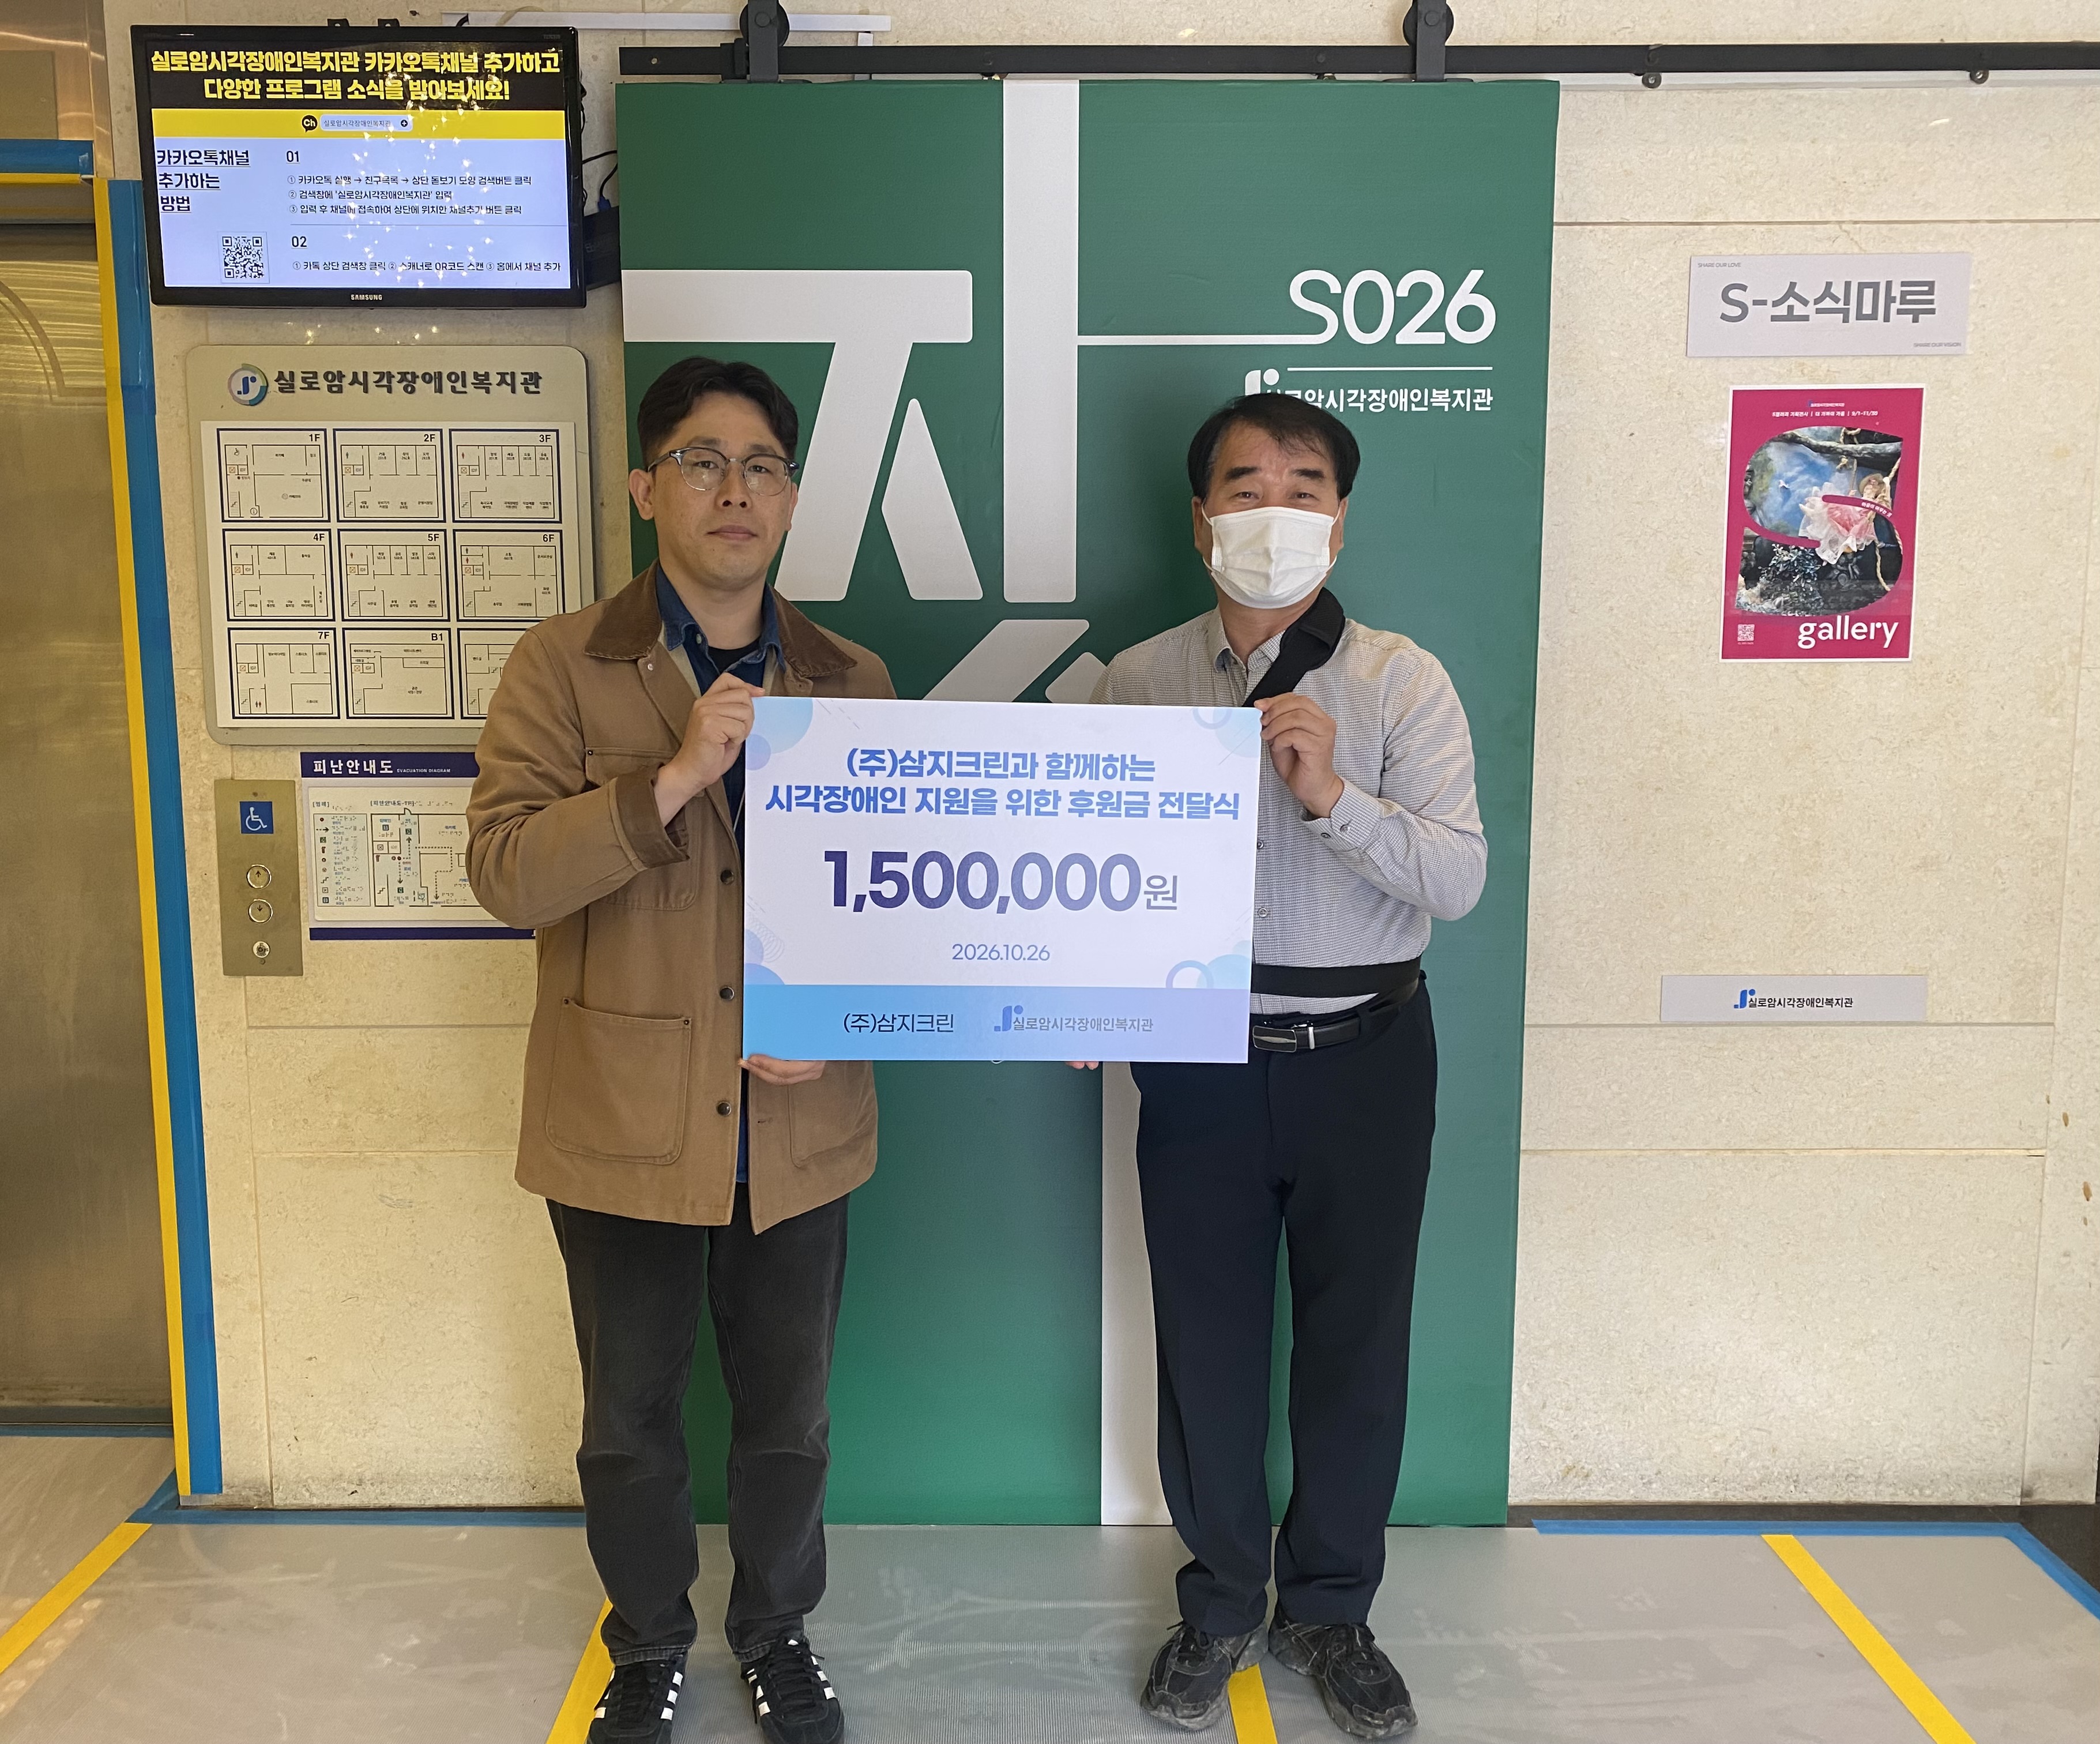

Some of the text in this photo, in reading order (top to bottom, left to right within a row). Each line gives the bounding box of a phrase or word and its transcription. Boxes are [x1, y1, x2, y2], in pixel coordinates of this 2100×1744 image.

[151, 51, 560, 73] 실로암시각장애인복지관 카카오톡채널 추가하고
[204, 78, 510, 101] 다양한 프로그램 소식을 받아보세요!
[303, 119, 316, 127] Ch
[157, 149, 250, 166] 카카오톡채널
[286, 151, 299, 162] 01
[159, 172, 220, 189] 추가하는
[298, 175, 332, 185] 카카오톡
[412, 176, 428, 185] 상단
[431, 176, 457, 185] 돋보기
[514, 176, 531, 185] 클릭
[299, 190, 333, 199] 검색창에
[435, 190, 452, 200] 입력
[160, 196, 190, 212] 방법
[300, 205, 317, 214] 입력
[319, 205, 328, 214] 후
[357, 205, 391, 214] 접속하여
[394, 205, 419, 214] 상단에
[421, 205, 447, 215] 위치한
[505, 206, 522, 215] 클릭
[292, 236, 307, 247] 02
[303, 261, 319, 270] 카톡
[322, 261, 339, 270] 상단
[342, 261, 367, 270] 검색창
[369, 262, 386, 270] 클릭
[467, 262, 484, 270] 스캔
[497, 262, 522, 272] 홈에서
[524, 262, 541, 272] 채널
[544, 262, 560, 272] 추가
[1720, 280, 1936, 324] S-소식마루
[274, 370, 542, 394] 실로암시각장애인복지관
[1267, 389, 1493, 412] 암시각장애인복지관
[309, 434, 320, 442] 1F
[424, 434, 435, 442] 2F
[539, 434, 551, 443] 3F
[428, 533, 439, 542] 5F
[543, 534, 554, 542] 6F
[1798, 615, 1899, 649] gallery
[313, 760, 393, 775] 피난안내도
[847, 748, 1156, 781] (주)삼지크린과 함께하는
[766, 785, 1240, 820] 시각장애인 지원을 위한 후원금 전달식
[825, 850, 1177, 914] 1,500,000원
[952, 944, 1051, 961] 2026.10.26
[1748, 997, 1853, 1008] 실로암시각장애인복지관
[843, 1013, 954, 1033] (주)삼지크린
[1013, 1017, 1153, 1032] 실로암시각장애인복지관
